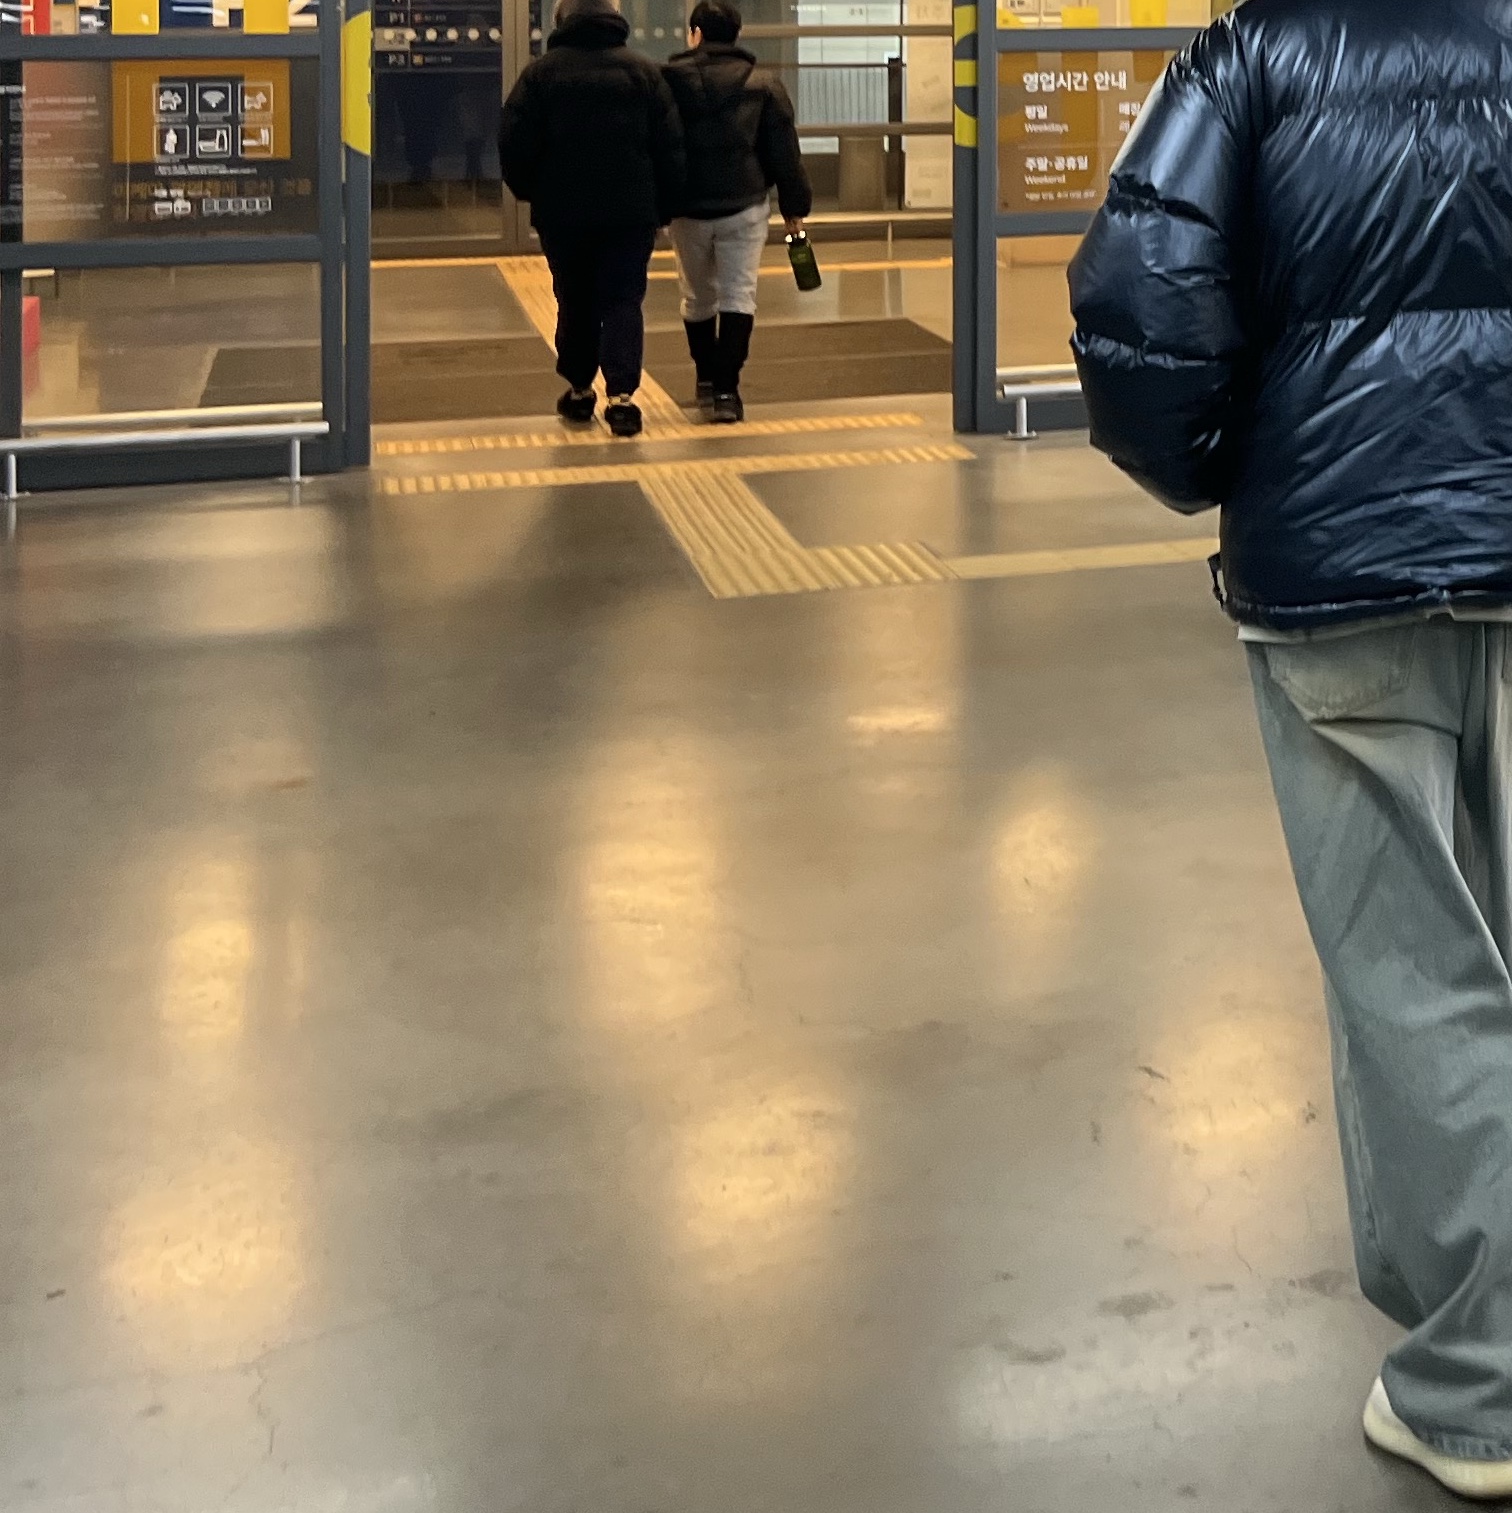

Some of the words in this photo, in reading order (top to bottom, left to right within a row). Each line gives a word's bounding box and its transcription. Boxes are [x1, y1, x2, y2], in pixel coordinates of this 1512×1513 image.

[1022, 70, 1089, 93] 영업시간
[1093, 69, 1127, 91] 안내
[1023, 174, 1066, 185] Weekend
